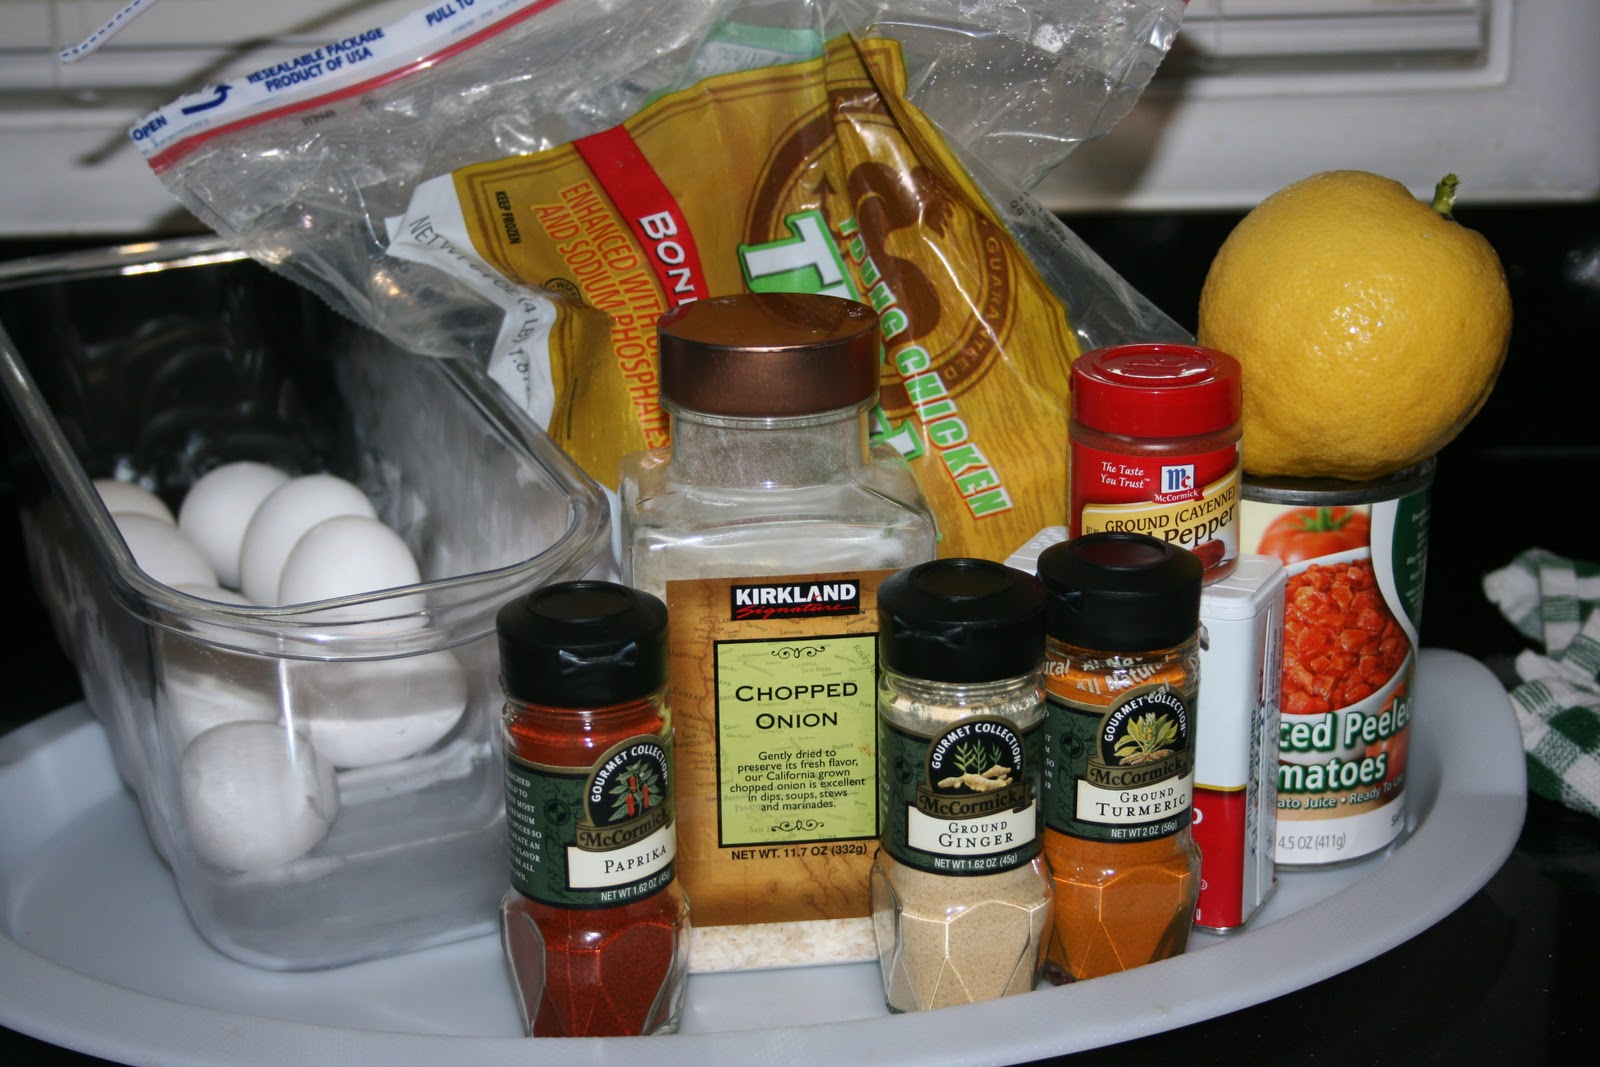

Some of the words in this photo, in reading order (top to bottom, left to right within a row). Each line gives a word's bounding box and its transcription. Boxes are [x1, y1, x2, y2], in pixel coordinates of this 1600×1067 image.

[425, 4, 456, 26] PULL
[246, 48, 325, 84] RESEALABLE
[325, 27, 385, 56] PACKAGE
[265, 63, 323, 92] PRODUCT
[326, 57, 343, 71] OF
[345, 46, 373, 64] USA
[132, 115, 168, 141] OPEN
[495, 191, 511, 211] KEEP
[501, 212, 522, 245] FROZEN
[534, 205, 580, 240] AND
[559, 240, 627, 312] SODIUM
[560, 181, 639, 272] ENHANCED
[619, 272, 662, 328] WITH
[896, 345, 1014, 521] CHICKEN
[1101, 461, 1117, 473] The
[1119, 464, 1144, 477] Taste
[1101, 474, 1117, 486] You
[1154, 489, 1199, 503] McCormick
[1105, 514, 1170, 533] GROUND
[1174, 485, 1236, 528] (CAYENNE)
[1163, 504, 1235, 547] Pepper
[736, 583, 857, 606] KIRKLAND
[736, 603, 857, 621] Signature
[735, 682, 859, 703] CHOPPED
[755, 712, 838, 730] ONION
[1104, 696, 1145, 742] GOURMET
[1279, 713, 1333, 748] ced
[758, 750, 793, 762] Gently
[796, 749, 822, 759] dried
[932, 725, 971, 769] GOURMET
[591, 750, 628, 802] GOURMET
[738, 763, 782, 774] preserve
[786, 761, 797, 770] its
[800, 757, 826, 769] fresh
[828, 758, 859, 767] flavor,
[745, 774, 763, 782] our
[766, 771, 815, 782] California
[818, 769, 850, 780] grown
[1090, 757, 1182, 786] McCormick
[1278, 753, 1387, 789] matoes
[730, 781, 774, 795] chopped
[777, 781, 806, 790] onion
[809, 780, 817, 789] is
[820, 777, 866, 788] excellent
[748, 793, 757, 802] in
[760, 791, 784, 803] dips,
[786, 790, 817, 801] soups,
[819, 789, 848, 798] stews
[1120, 787, 1174, 804] GROUND
[761, 801, 779, 811] and
[782, 800, 836, 811] marinades.
[920, 790, 1016, 816] McCormick
[1096, 794, 1186, 818] TURMERIC
[1277, 797, 1300, 809] ato
[1305, 796, 1336, 809] Juice
[1350, 787, 1381, 804] Ready
[580, 807, 668, 847] McCormick
[949, 821, 1008, 834] GROUND
[1111, 828, 1127, 838] NET
[1128, 828, 1141, 838] WT
[1142, 828, 1148, 837] 2
[1149, 825, 1159, 836] OZ
[1161, 820, 1178, 834] (56g)
[530, 841, 541, 851] AN
[938, 832, 1013, 848] GINGER
[1278, 836, 1295, 850] 4.5
[1297, 835, 1313, 850] OZ
[1315, 832, 1346, 851] (411g)
[604, 844, 667, 874] PAPRIKA
[731, 850, 756, 861] NET
[758, 849, 780, 859] WT.
[784, 847, 807, 858] 11.7
[811, 846, 828, 856] OZ
[831, 843, 867, 857] (332g)
[935, 858, 950, 868] NET
[951, 860, 966, 869] WT
[967, 860, 984, 869] 1.62
[986, 858, 997, 868] OZ
[999, 853, 1018, 867] (45g)
[601, 889, 617, 901] NET
[618, 887, 632, 899] WT
[633, 882, 647, 895] 1.62
[648, 877, 657, 889] OZ
